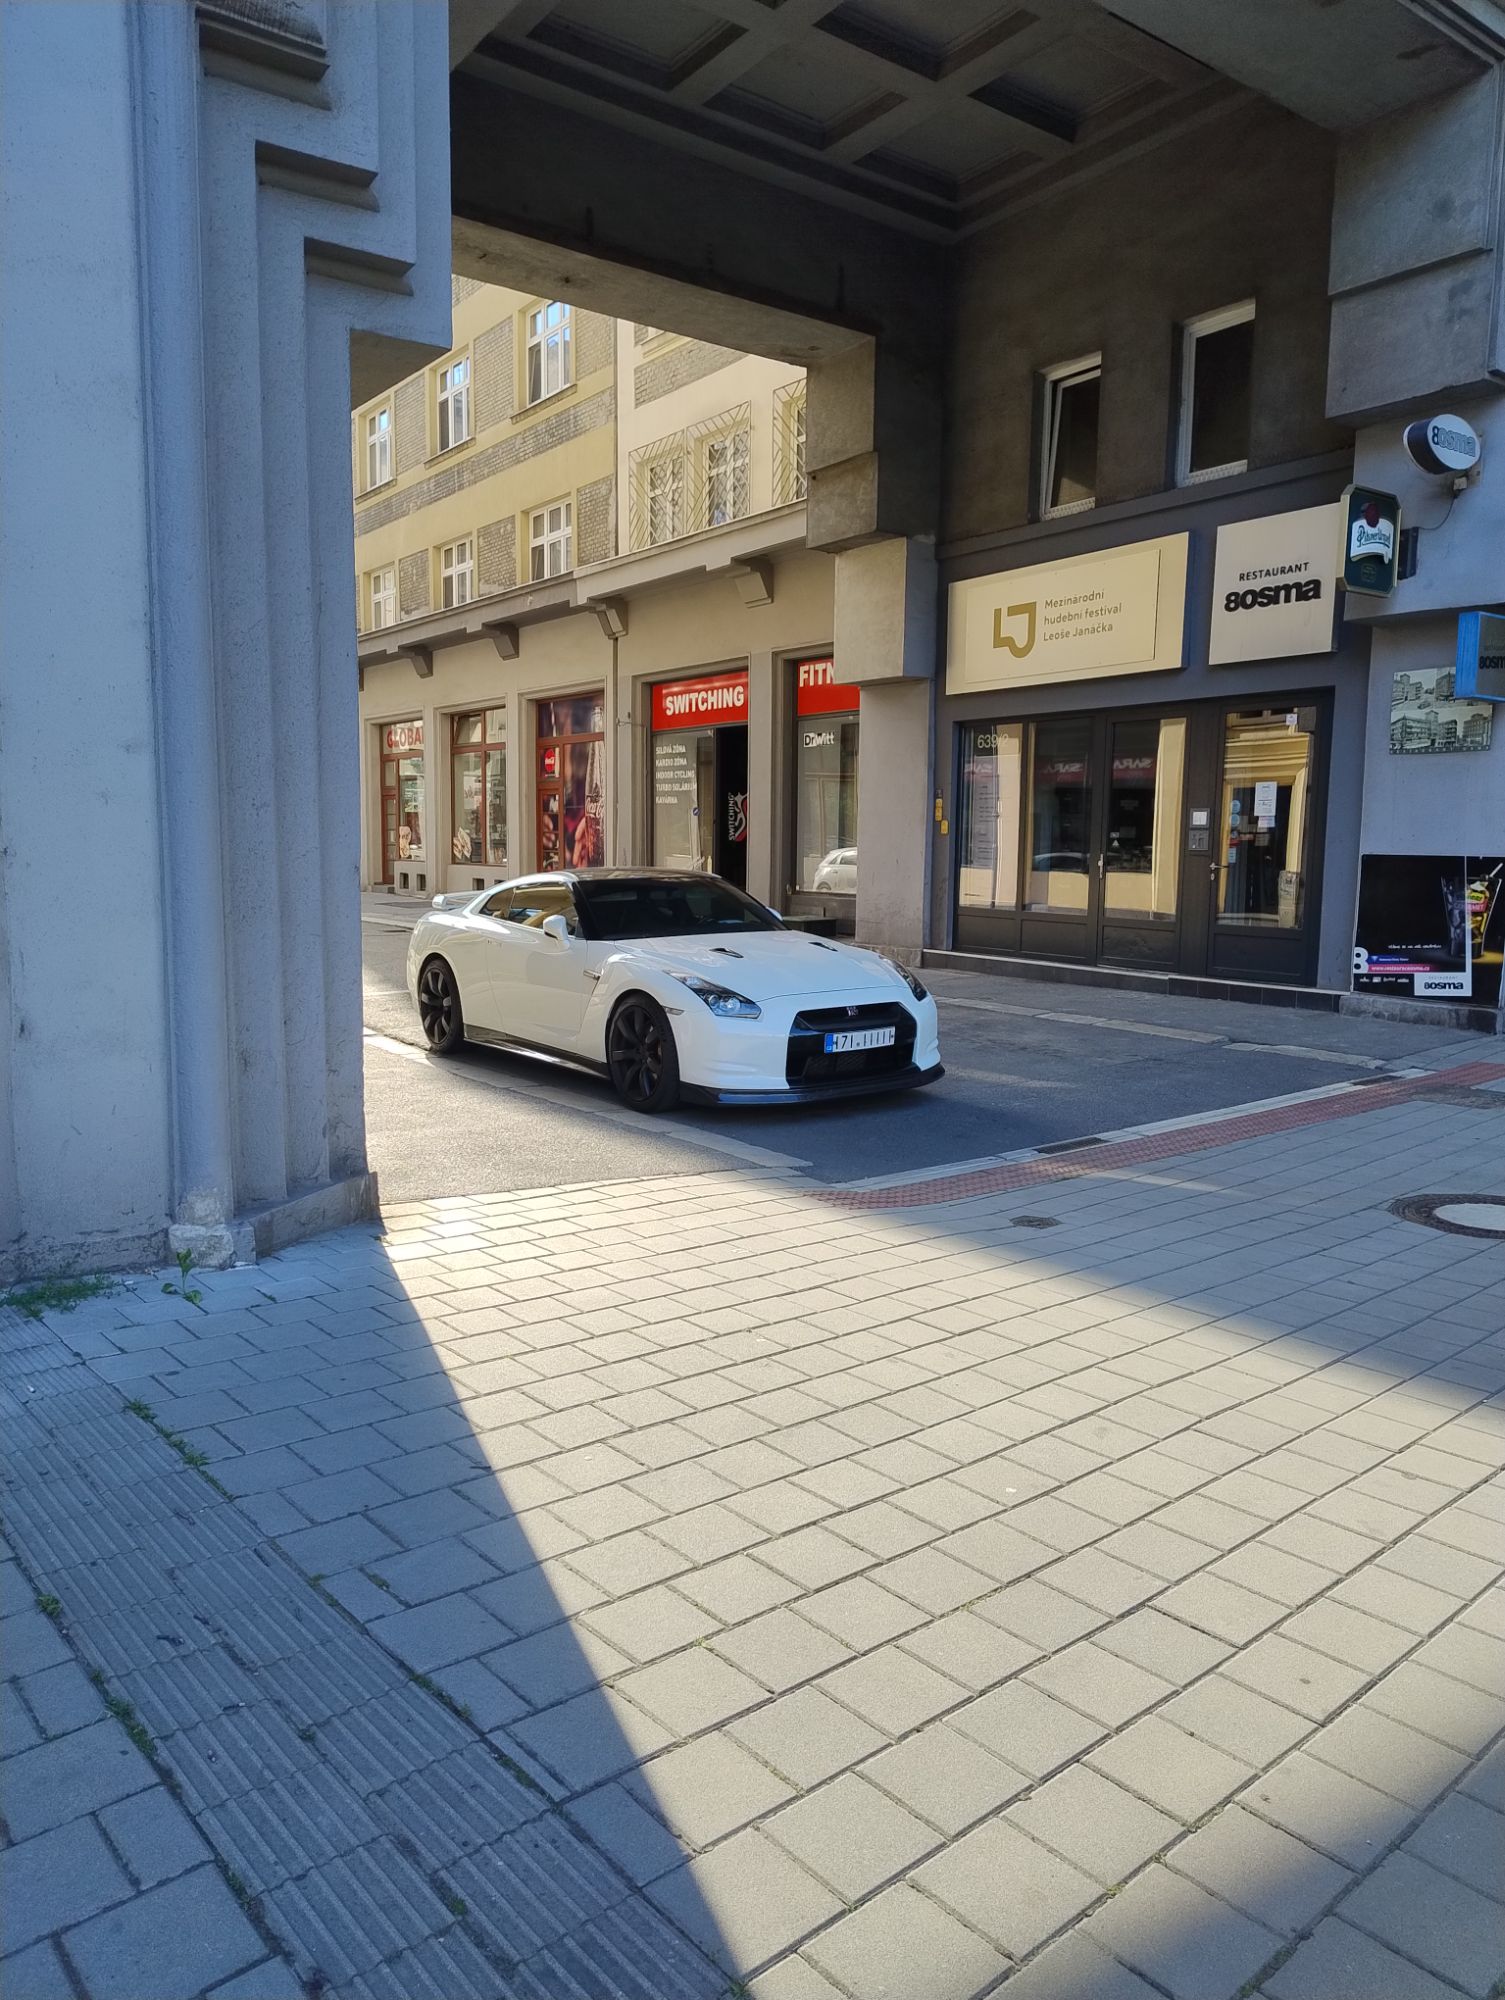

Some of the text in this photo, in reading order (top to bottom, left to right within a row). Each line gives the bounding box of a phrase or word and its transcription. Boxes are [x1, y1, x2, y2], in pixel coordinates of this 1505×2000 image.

[1239, 562, 1309, 581] RESTAURANT
[1224, 579, 1321, 612] 8osma
[1085, 602, 1122, 619] festival
[1043, 622, 1113, 641] Leoše Janáčka
[666, 686, 744, 716] SWITCHING
